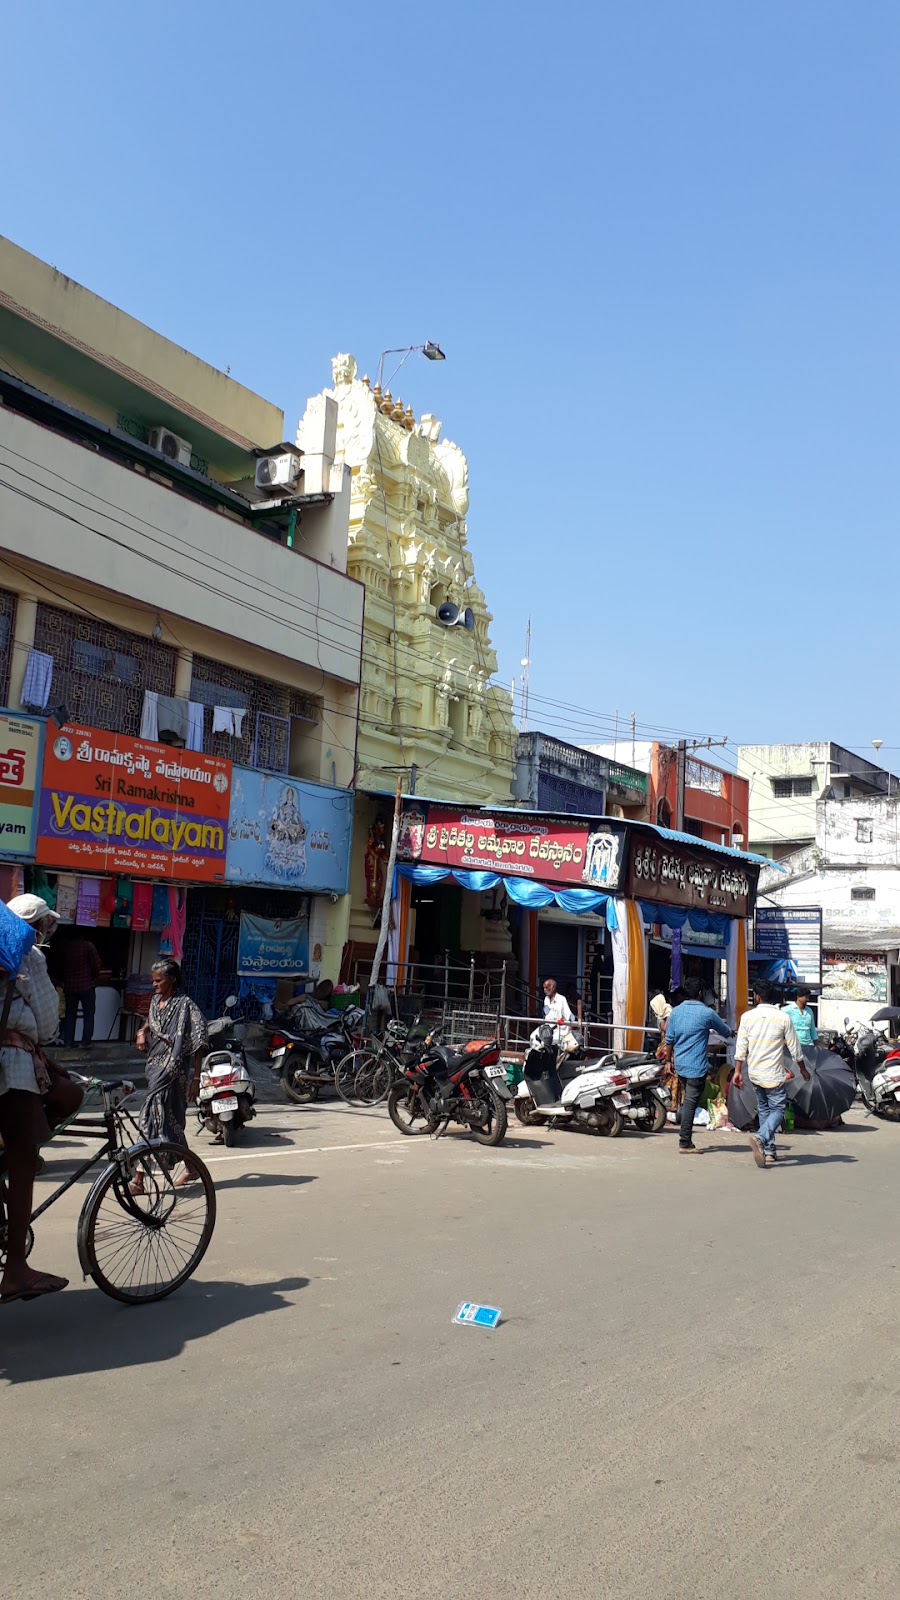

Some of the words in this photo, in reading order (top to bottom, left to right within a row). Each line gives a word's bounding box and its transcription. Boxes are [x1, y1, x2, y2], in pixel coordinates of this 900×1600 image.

[95, 774, 112, 793] Sri
[117, 778, 195, 808] Ramakrishna
[51, 792, 224, 852] Vastralayam
[426, 825, 438, 850] శ్రీ
[439, 827, 475, 855] పైడితల్లి
[477, 833, 526, 859] అమ్మవారి
[529, 836, 583, 869] దేవస్థానం
[834, 952, 873, 962] Paradise
